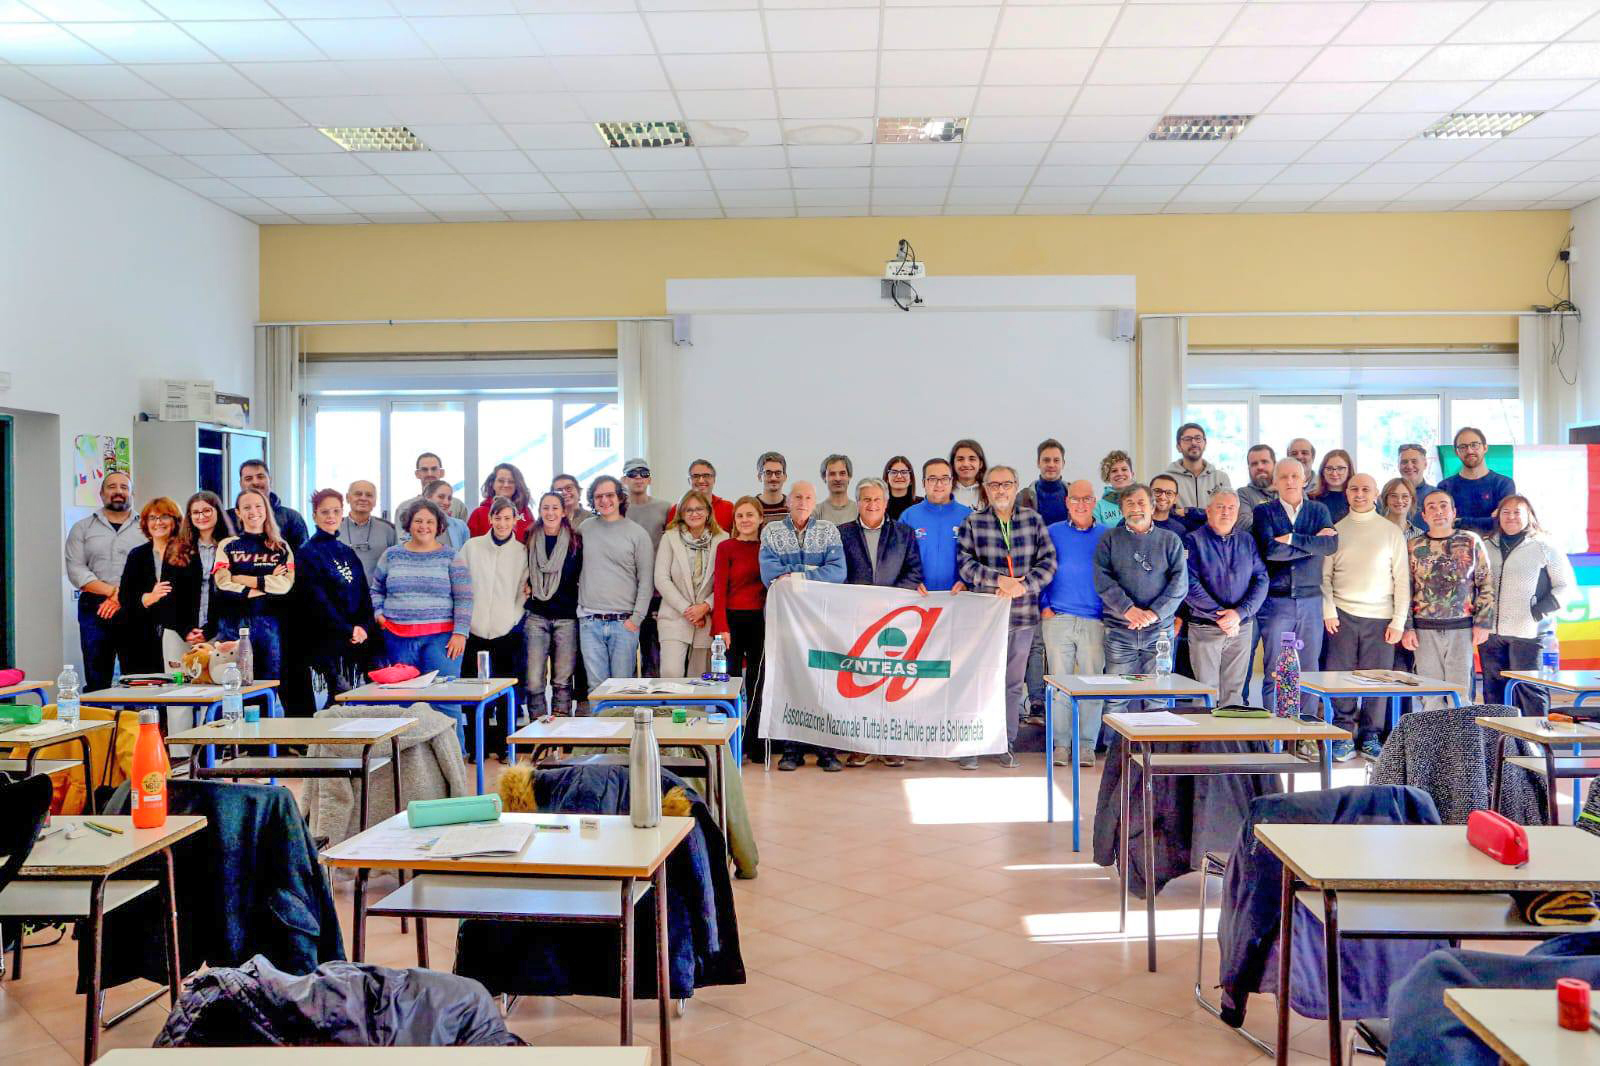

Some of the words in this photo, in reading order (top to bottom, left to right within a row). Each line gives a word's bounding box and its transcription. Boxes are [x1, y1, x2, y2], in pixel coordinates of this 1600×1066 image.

[782, 702, 825, 732] Associazione
[826, 713, 860, 737] Nazionale
[889, 718, 902, 740] Età
[903, 719, 924, 742] Attive
[925, 724, 938, 747] per
[939, 720, 946, 742] la
[946, 719, 984, 742] Solidarietà
